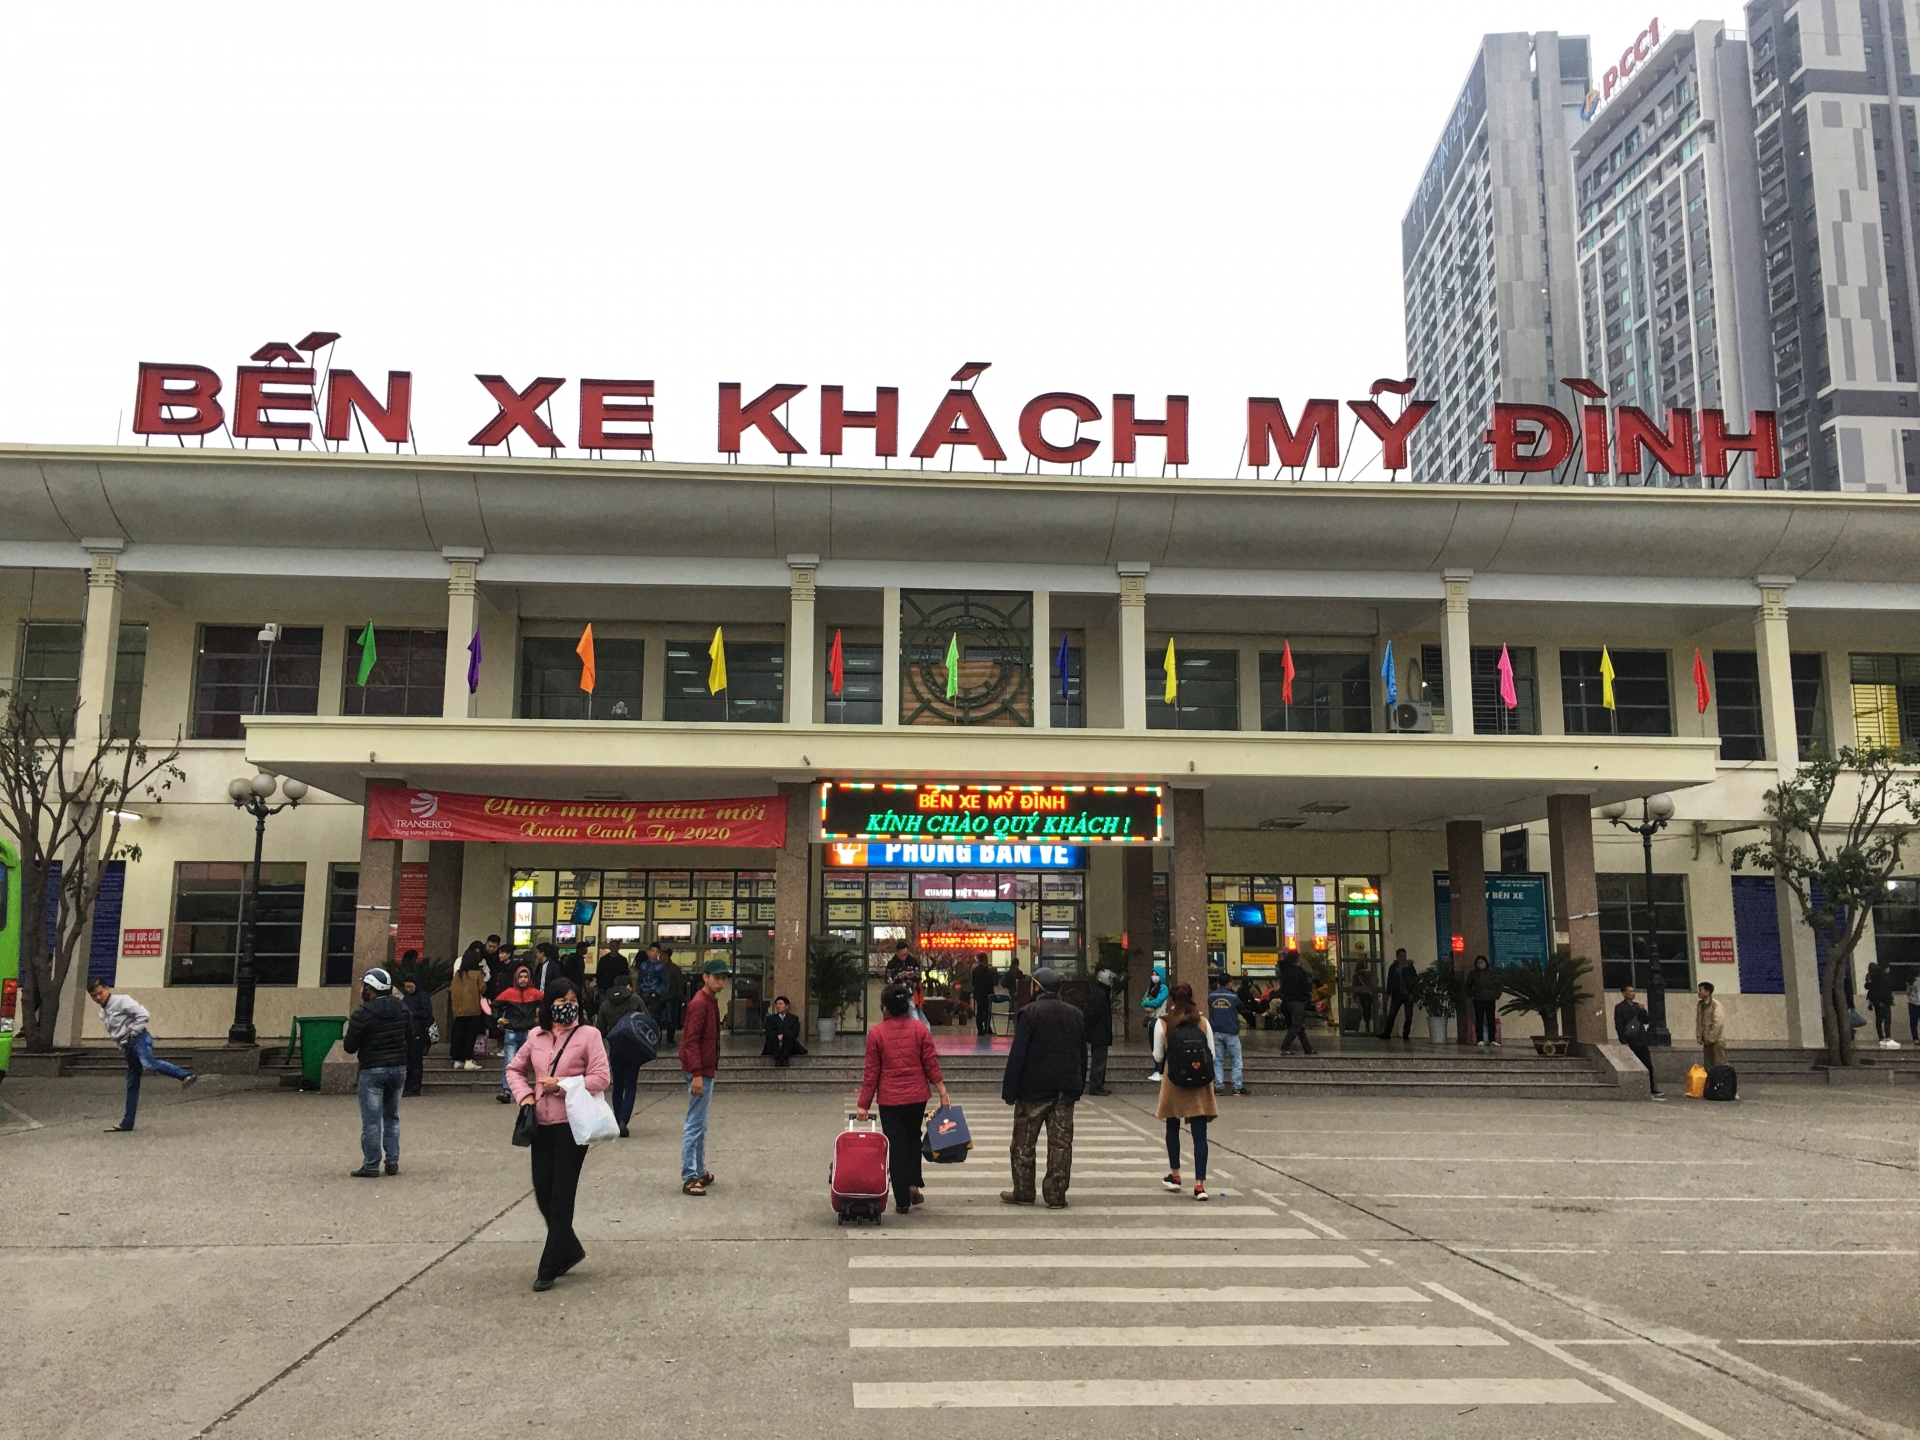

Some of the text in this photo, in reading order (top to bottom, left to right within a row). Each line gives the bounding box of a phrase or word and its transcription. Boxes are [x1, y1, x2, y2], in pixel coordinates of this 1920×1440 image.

[1603, 16, 1659, 100] PCC1
[132, 331, 1781, 480] BẾN XE KHÁCH MỸ ĐÌNH
[918, 789, 953, 808] BẾN
[959, 794, 981, 809] XE
[1019, 791, 1066, 809] ĐÌNH
[484, 797, 766, 823] Chúc mừng năm mới
[396, 819, 452, 829] TRANSERCO
[520, 821, 731, 842] Xuân Canh Tý 2020
[865, 809, 924, 832] KÍNH
[926, 810, 989, 833] CHÀO
[993, 811, 1040, 837] QUÝ
[1042, 811, 1120, 834] KHÁCH
[924, 888, 953, 897] KUMHO
[1492, 889, 1510, 900] BẾN
[1512, 891, 1524, 900] XE
